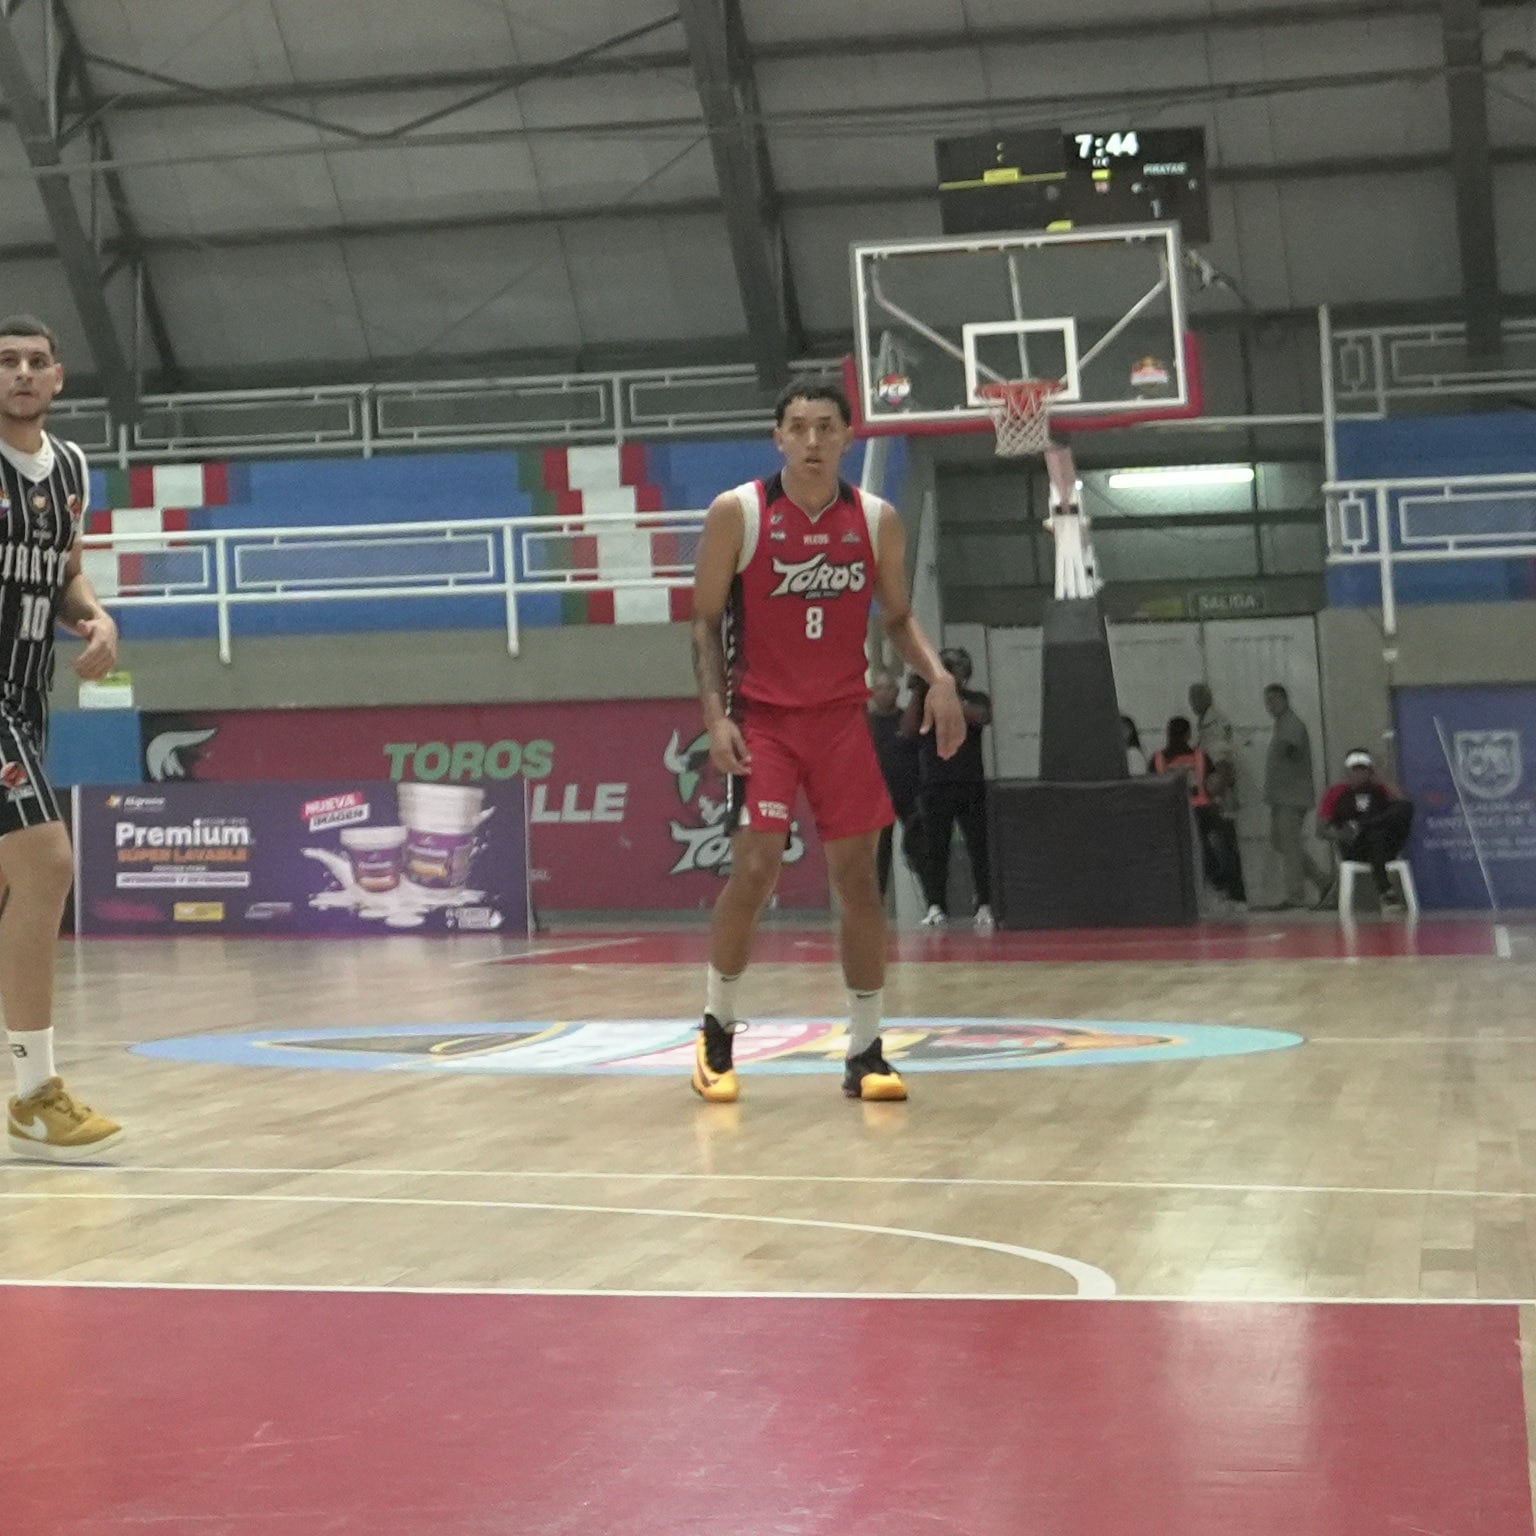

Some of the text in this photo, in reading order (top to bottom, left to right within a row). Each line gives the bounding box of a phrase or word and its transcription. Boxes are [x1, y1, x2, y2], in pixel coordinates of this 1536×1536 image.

[1075, 131, 1140, 159] 7:44
[770, 552, 866, 597] TOROS
[19, 592, 51, 641] 10
[805, 606, 825, 640] 8
[383, 739, 555, 782] TOROS
[115, 817, 249, 846] Premium
